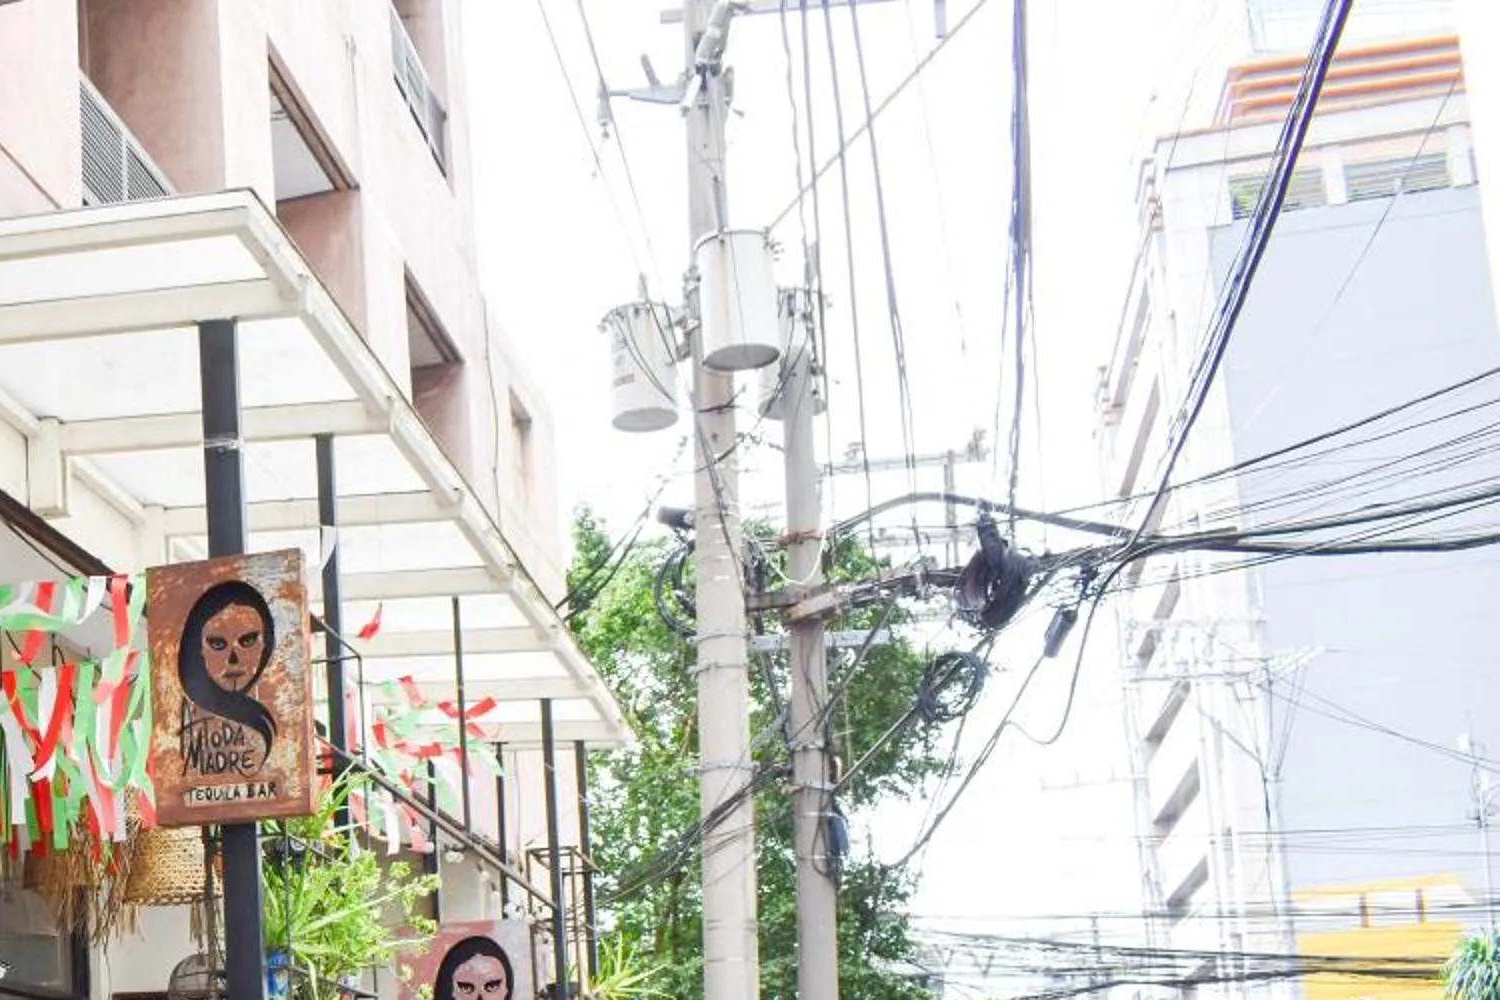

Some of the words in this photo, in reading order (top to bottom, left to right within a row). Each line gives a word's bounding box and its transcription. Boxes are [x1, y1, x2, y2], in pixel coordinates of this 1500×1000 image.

[182, 735, 255, 777] MADRE
[188, 785, 241, 802] TEQUILA
[246, 781, 278, 799] BAR
